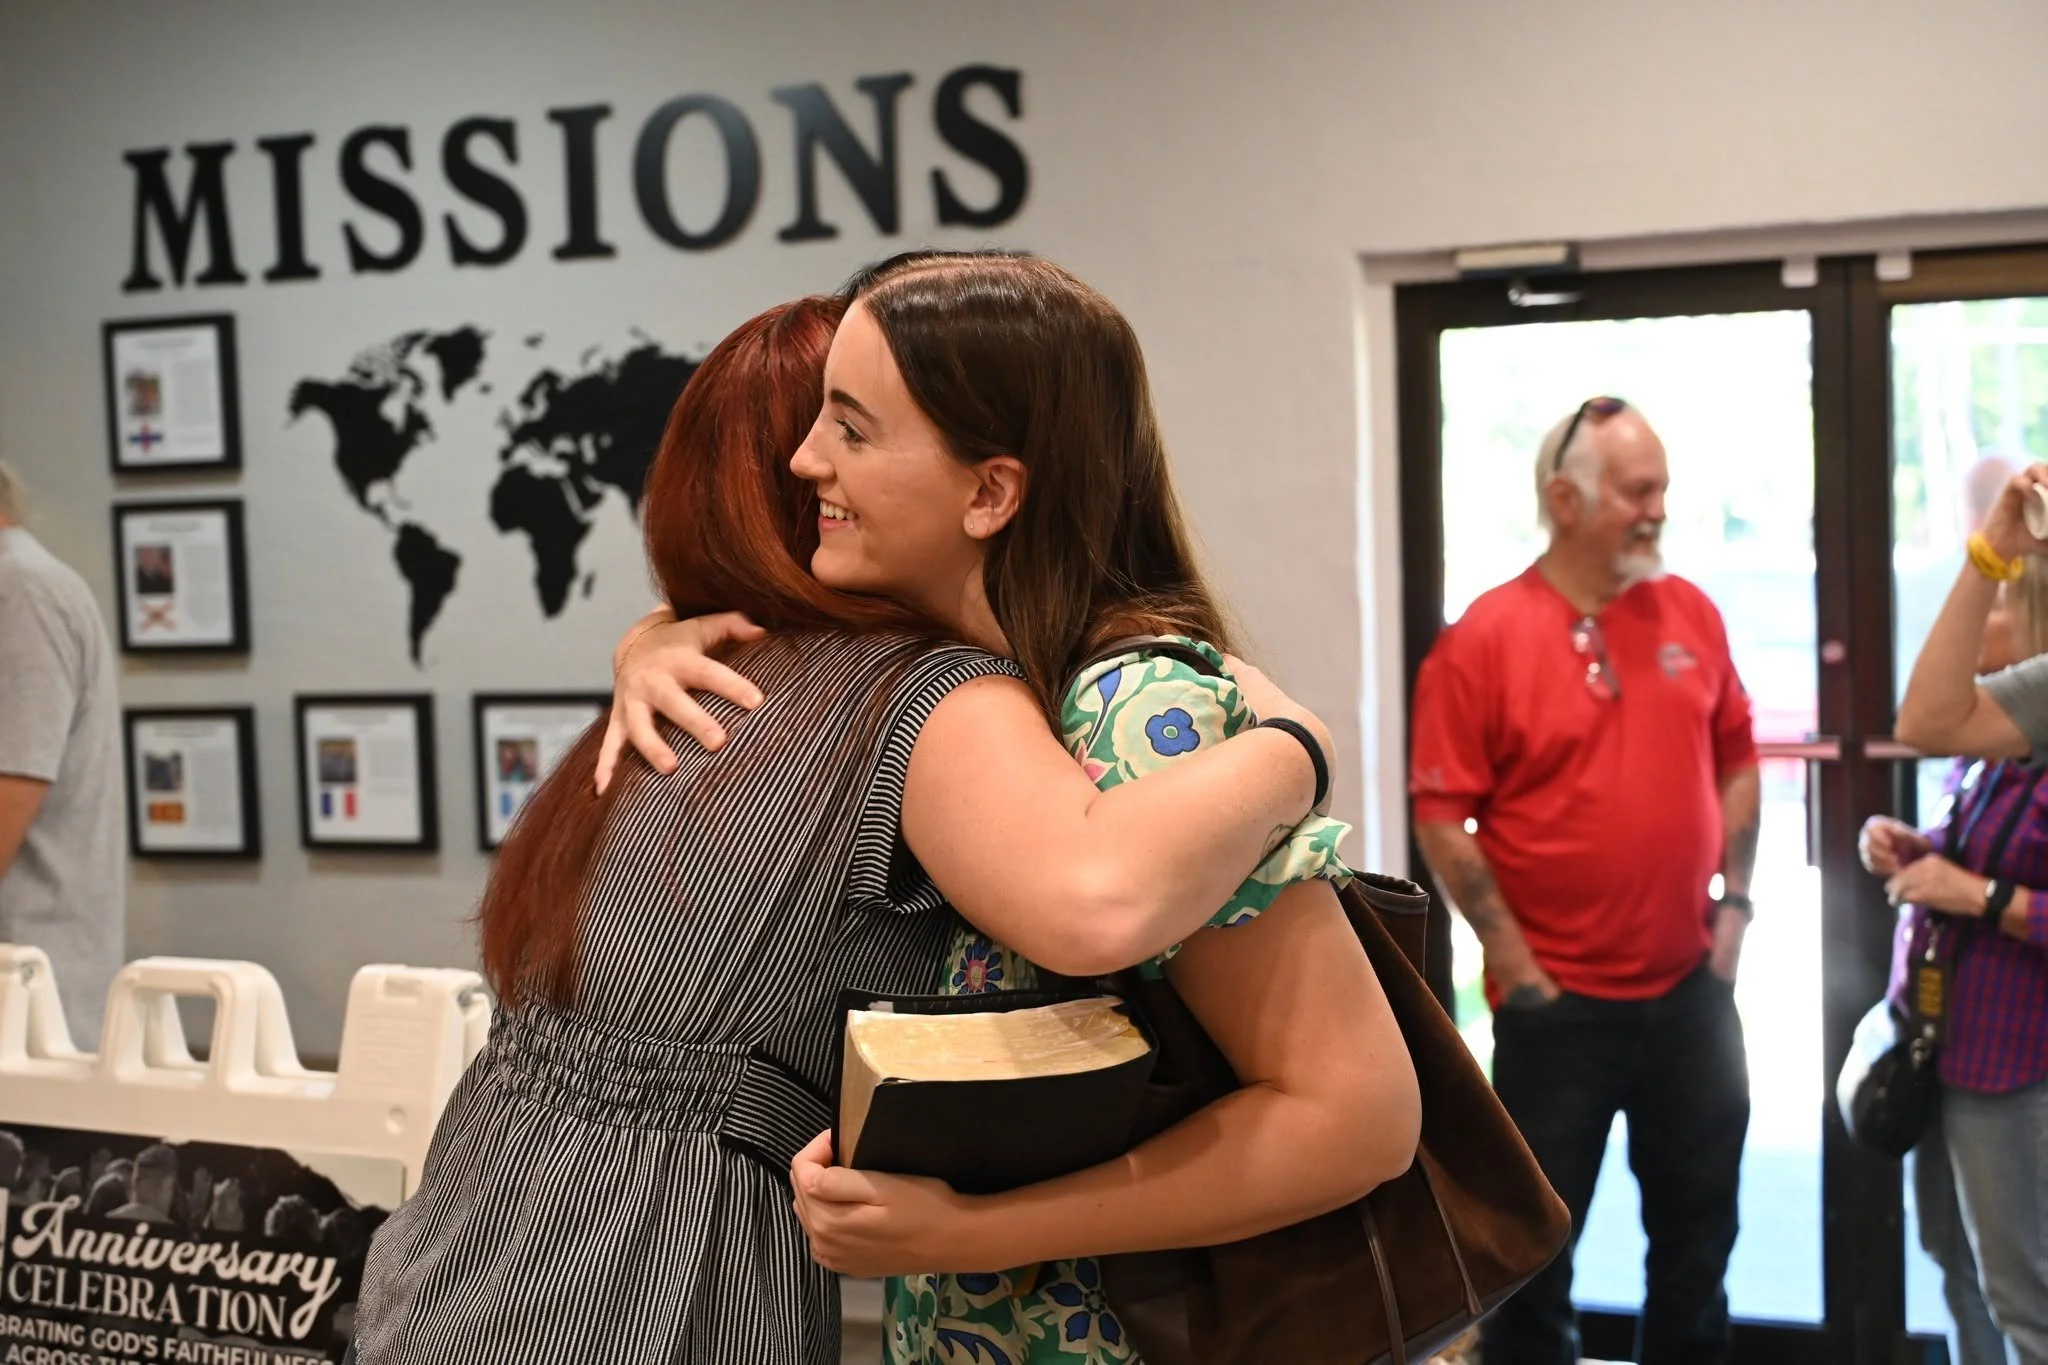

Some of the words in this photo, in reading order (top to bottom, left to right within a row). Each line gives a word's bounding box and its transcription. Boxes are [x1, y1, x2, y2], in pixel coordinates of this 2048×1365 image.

[121, 65, 1031, 294] MISSIONS
[8, 1261, 287, 1338] CELEBRATION
[12, 1194, 342, 1339] Anniversary
[90, 1327, 158, 1358] GOD'S
